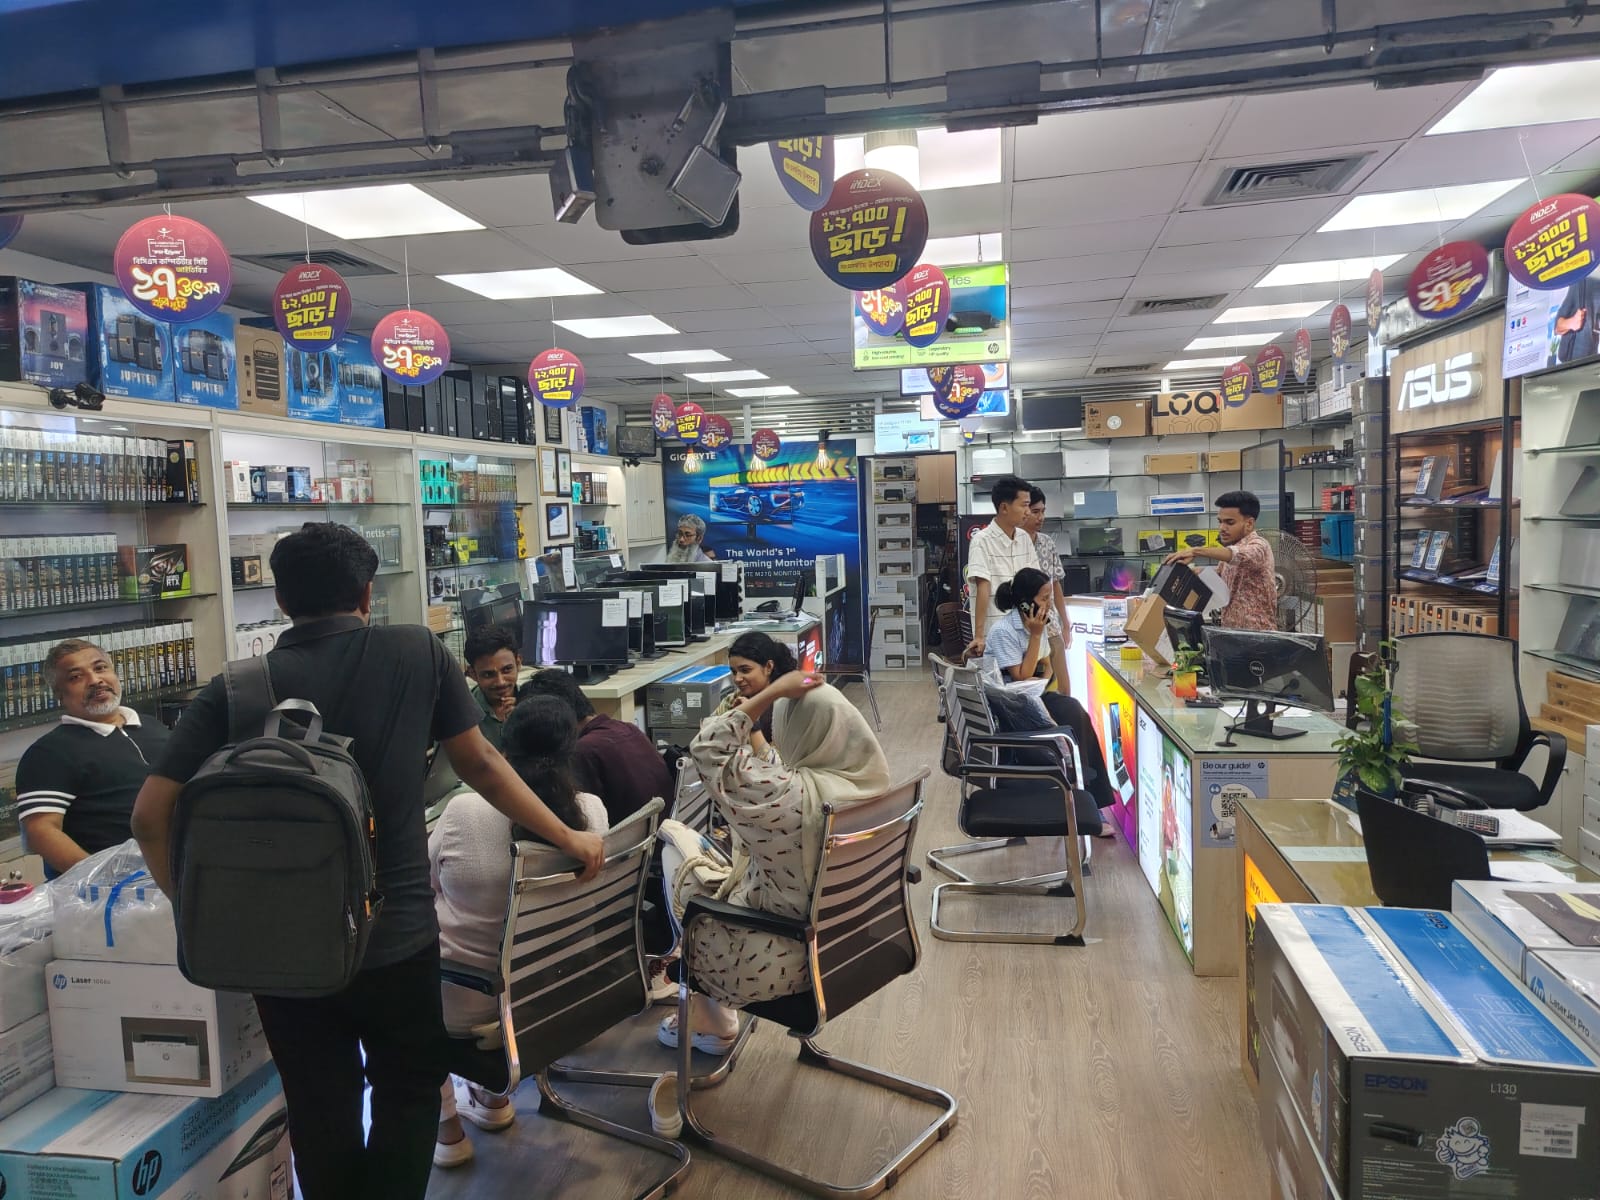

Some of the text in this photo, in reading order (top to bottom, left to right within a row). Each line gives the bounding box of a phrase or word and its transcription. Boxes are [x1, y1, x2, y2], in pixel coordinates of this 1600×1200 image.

[1530, 200, 1558, 222] INDEX
[948, 276, 971, 286] ries
[907, 289, 932, 307] ২,৭০০
[1397, 352, 1474, 411] ASUS
[1152, 391, 1220, 417] LOQ
[670, 452, 716, 461] GIGBYTE
[365, 530, 385, 538] netis
[725, 549, 743, 557] The
[746, 548, 783, 557] World's
[742, 561, 772, 569] aming
[1228, 762, 1251, 770] guide!
[53, 974, 67, 990] hp
[71, 976, 92, 985] Laser
[1549, 994, 1590, 1037] LaserJet Pro
[1344, 1026, 1371, 1053] EPSON
[1364, 1073, 1428, 1091] EPSON
[1490, 1083, 1517, 1095] L130
[132, 1150, 162, 1196] hp
